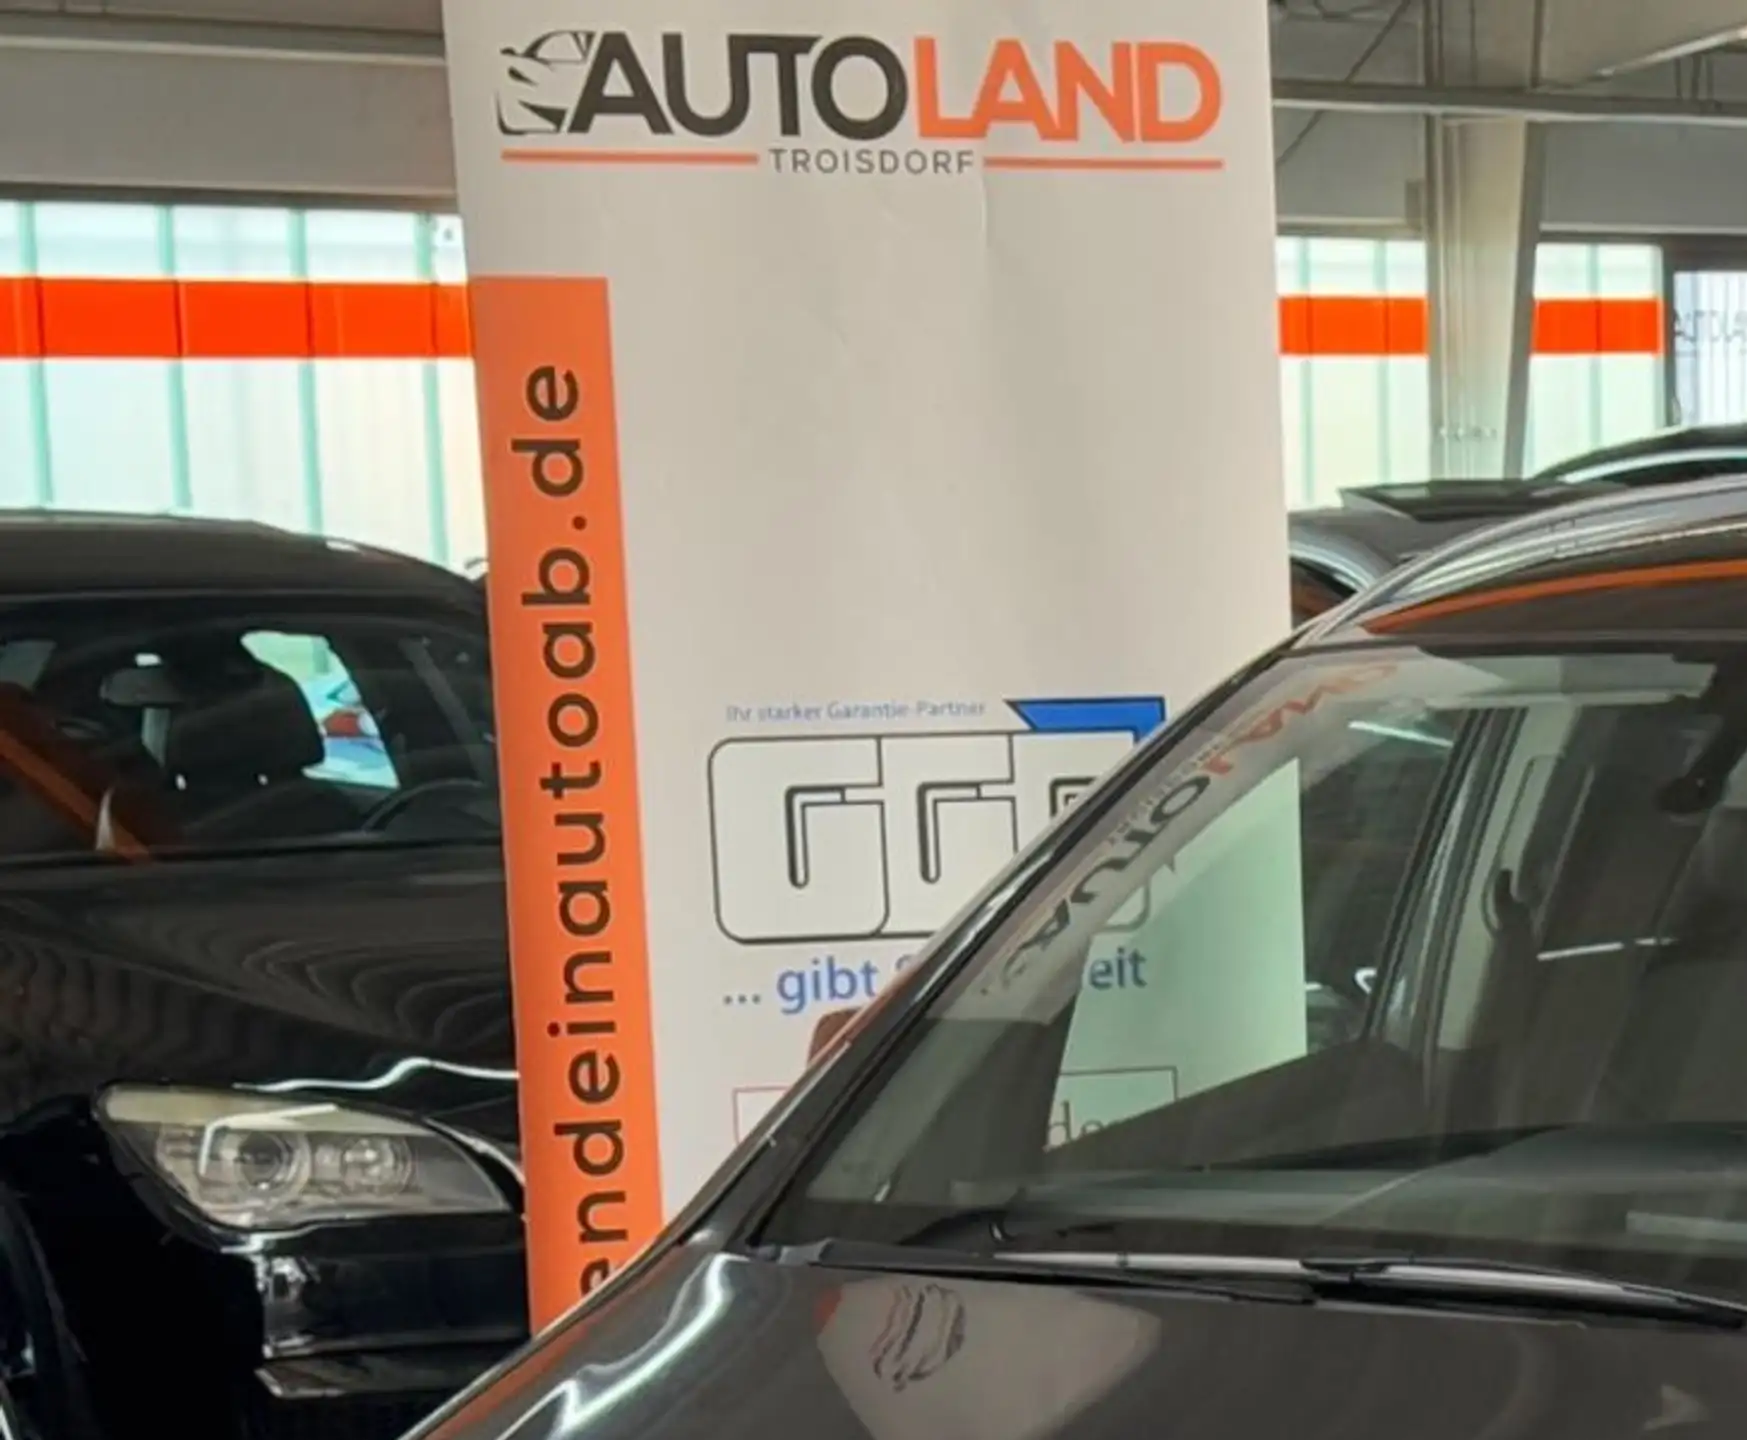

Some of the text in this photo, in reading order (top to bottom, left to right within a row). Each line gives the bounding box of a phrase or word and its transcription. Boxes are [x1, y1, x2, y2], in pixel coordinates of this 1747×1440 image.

[567, 30, 1222, 142] AUTOLAND
[768, 147, 975, 176] TROISDORF
[757, 703, 823, 720] starker
[776, 955, 879, 1015] gibt
